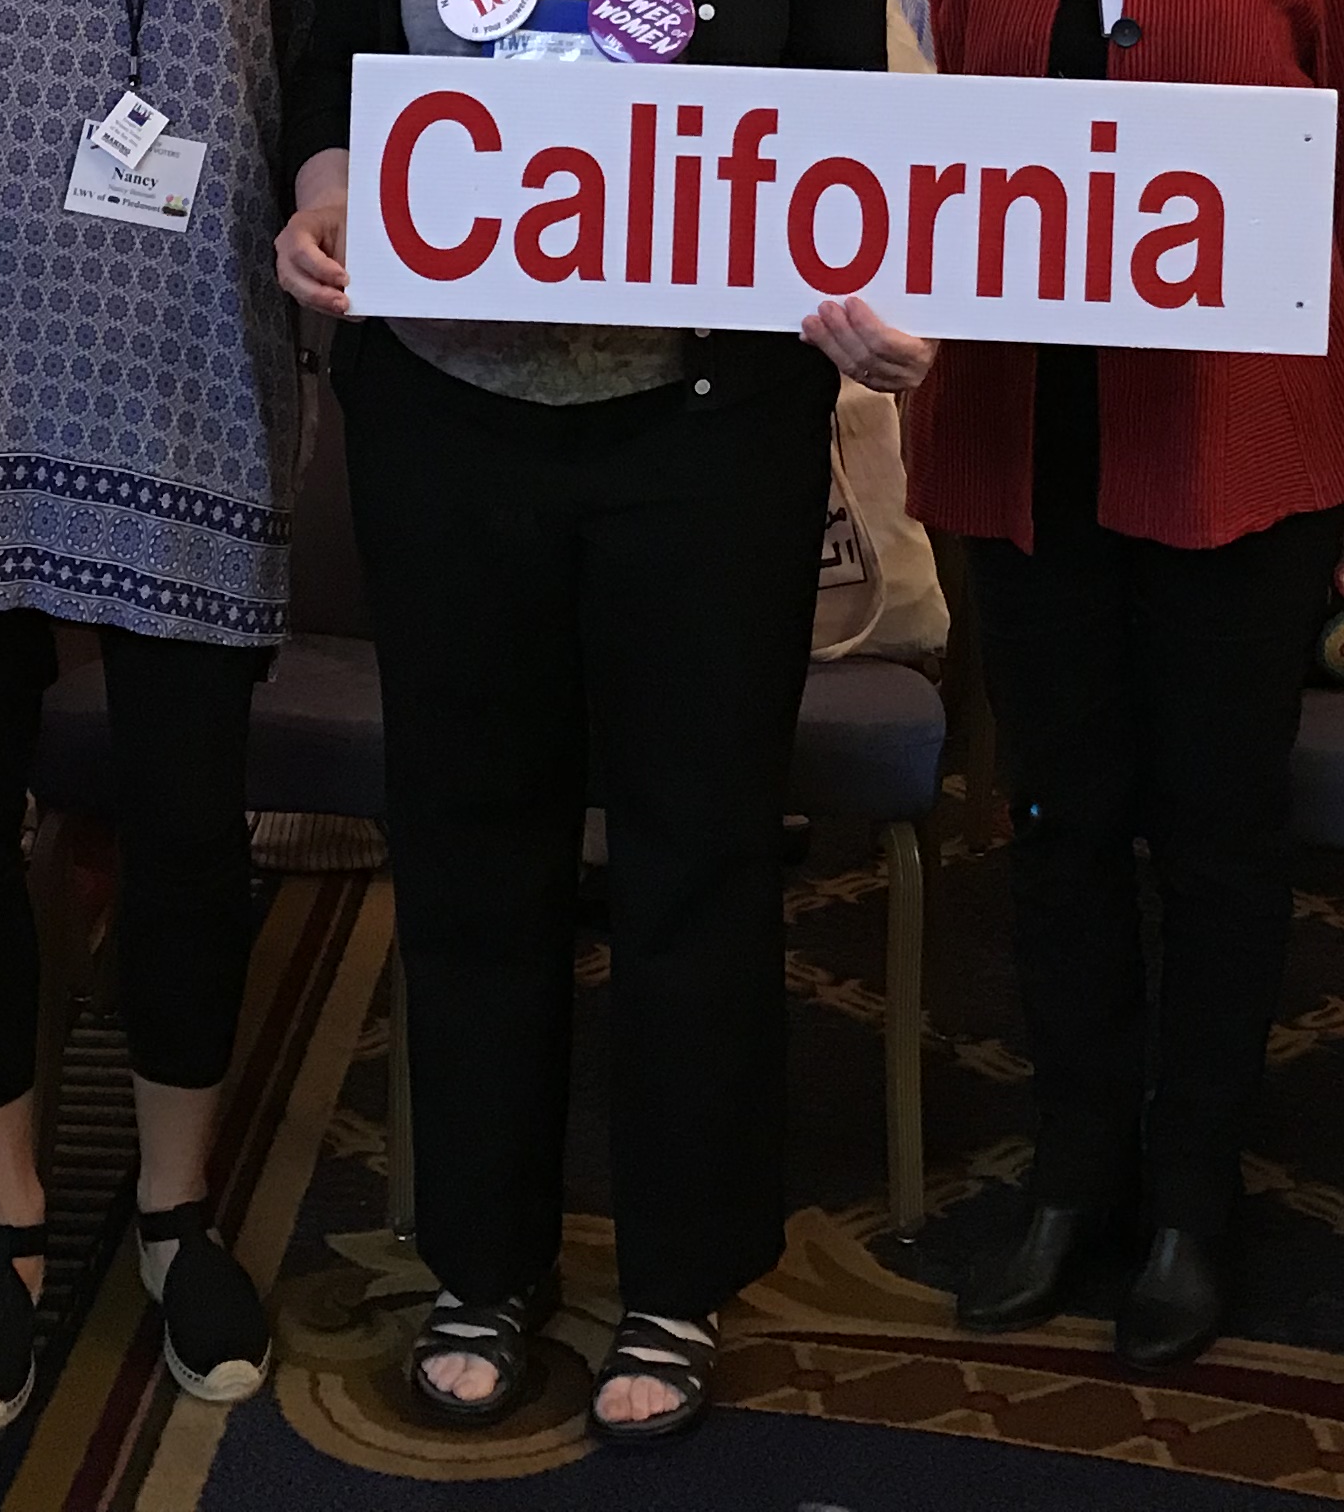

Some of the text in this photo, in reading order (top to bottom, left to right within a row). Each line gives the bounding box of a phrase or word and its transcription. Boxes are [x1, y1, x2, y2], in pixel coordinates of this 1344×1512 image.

[671, 2, 690, 15] THE
[472, 24, 478, 33] is
[484, 22, 501, 34] your
[592, 0, 681, 54] WOMEN
[671, 29, 687, 38] OF
[499, 36, 529, 50] LWV
[112, 167, 159, 190] Nancy
[73, 188, 95, 198] LWV
[122, 198, 160, 212] Piedmont
[380, 91, 1226, 310] California
